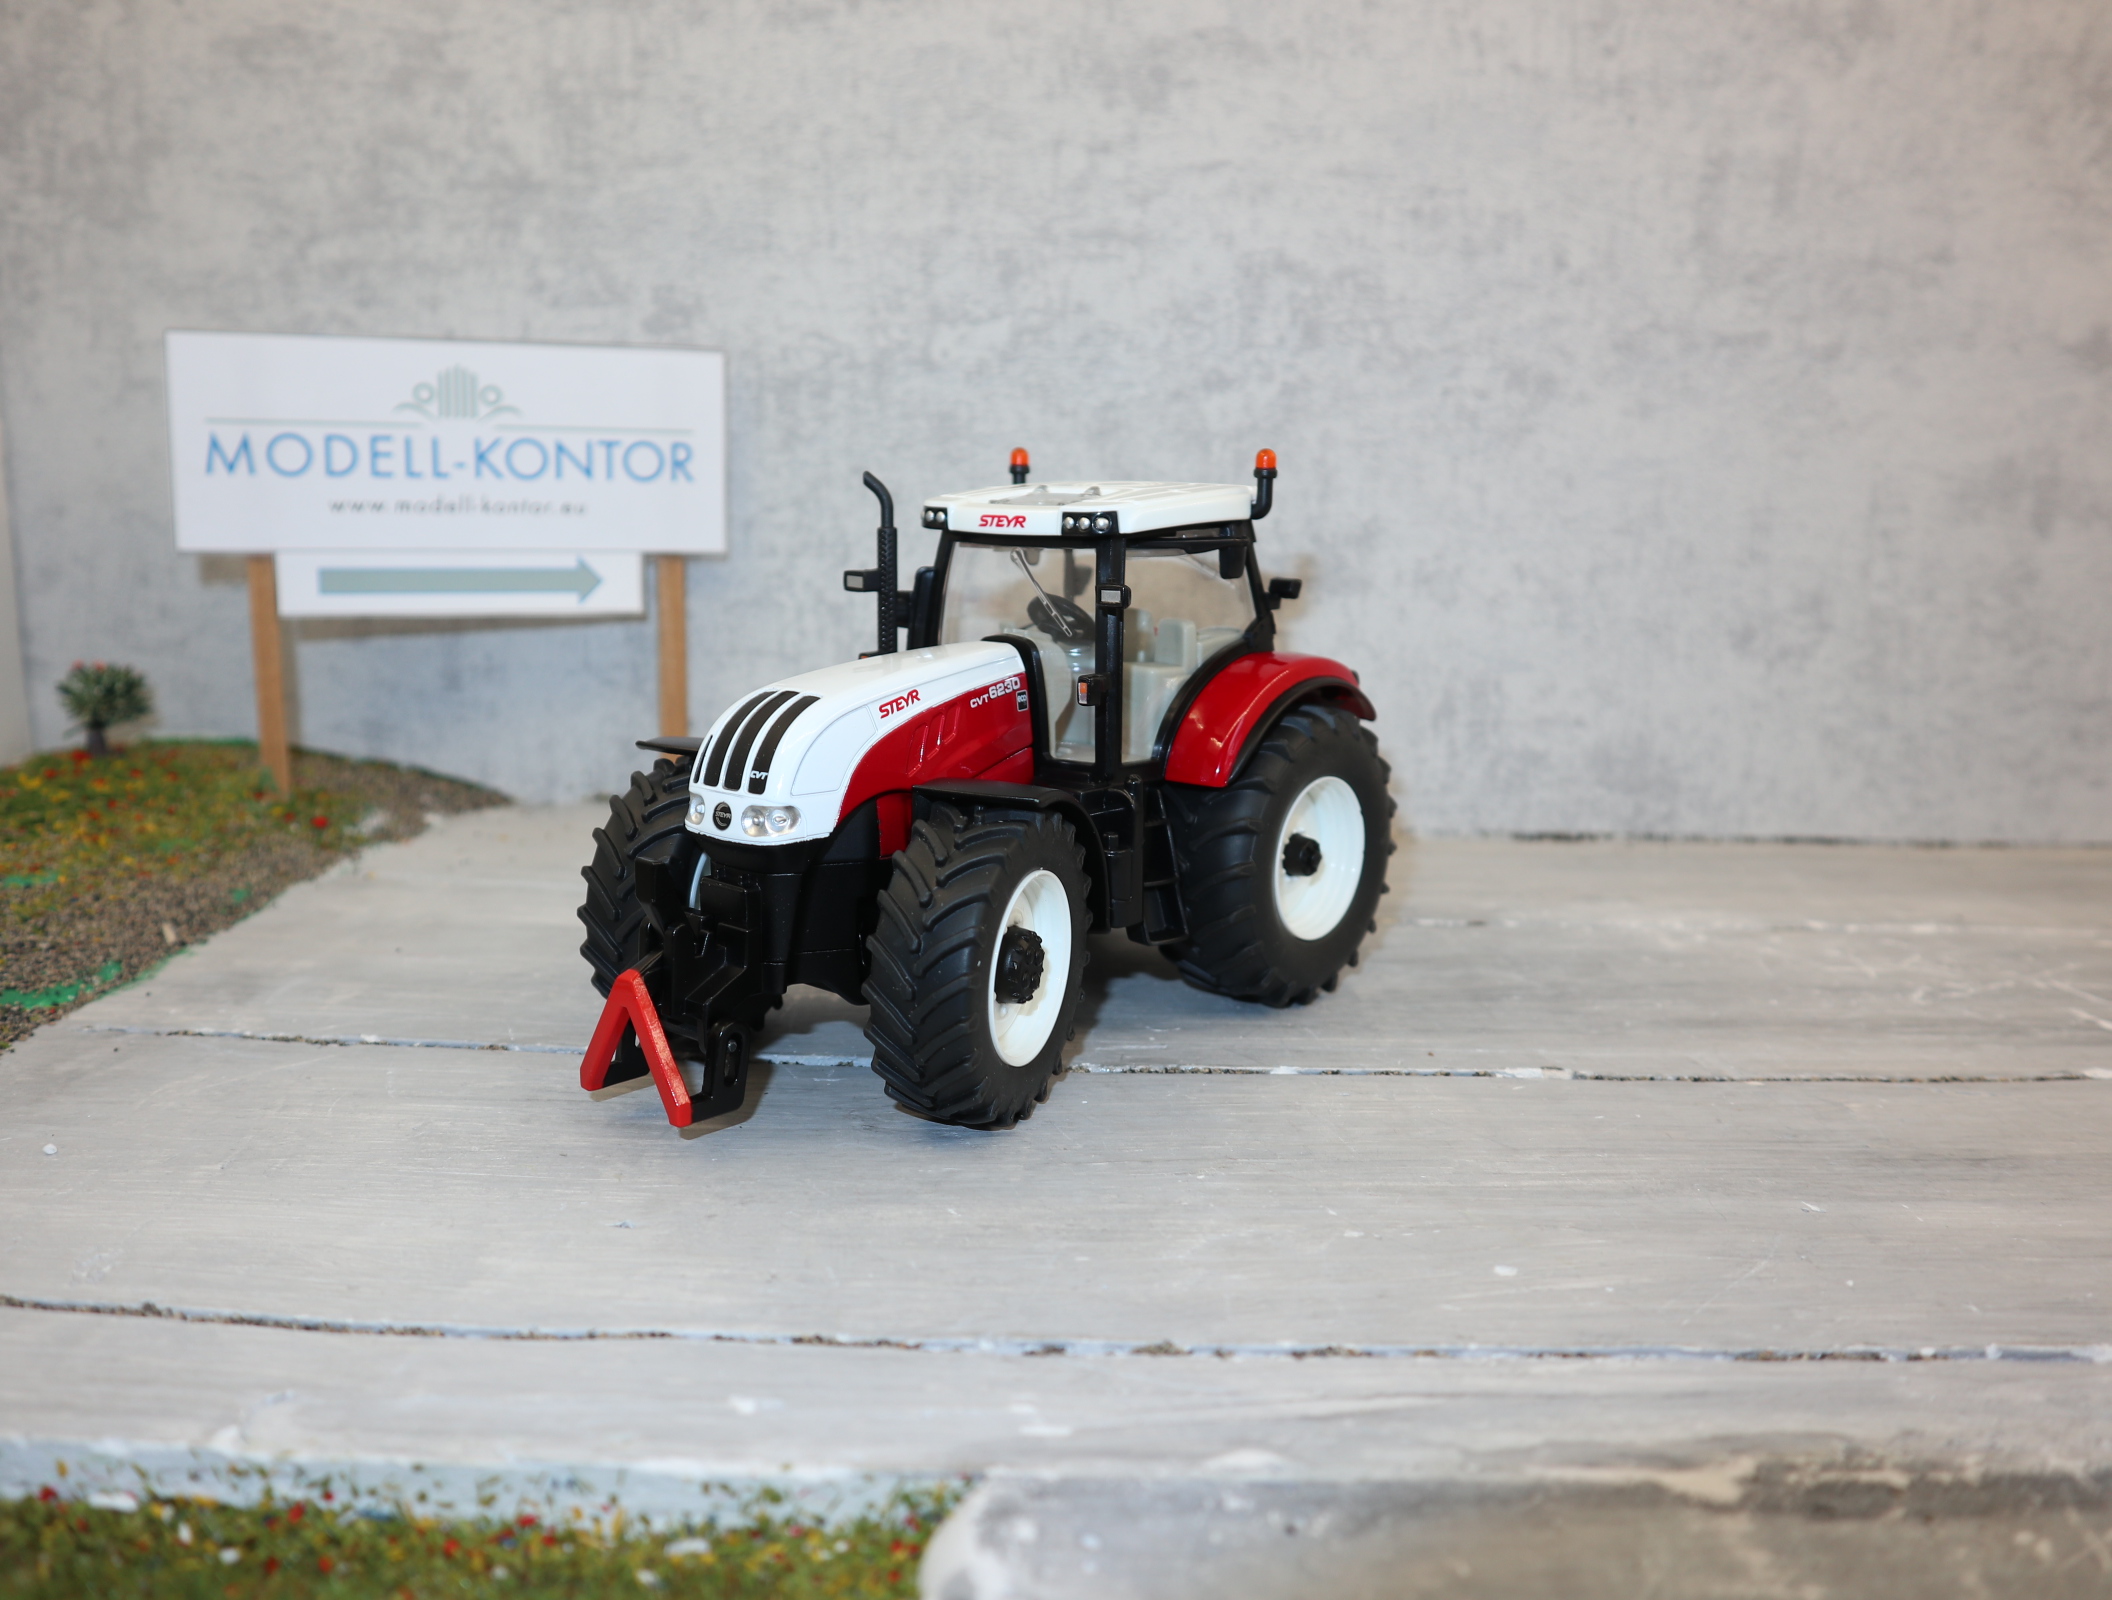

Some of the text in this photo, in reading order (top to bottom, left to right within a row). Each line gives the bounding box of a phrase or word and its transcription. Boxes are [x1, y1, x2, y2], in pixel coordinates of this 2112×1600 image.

[204, 432, 695, 483] MODELL-KONTOR
[978, 514, 1027, 528] STEYR
[878, 689, 921, 719] STEYR
[750, 770, 769, 780] CVT
